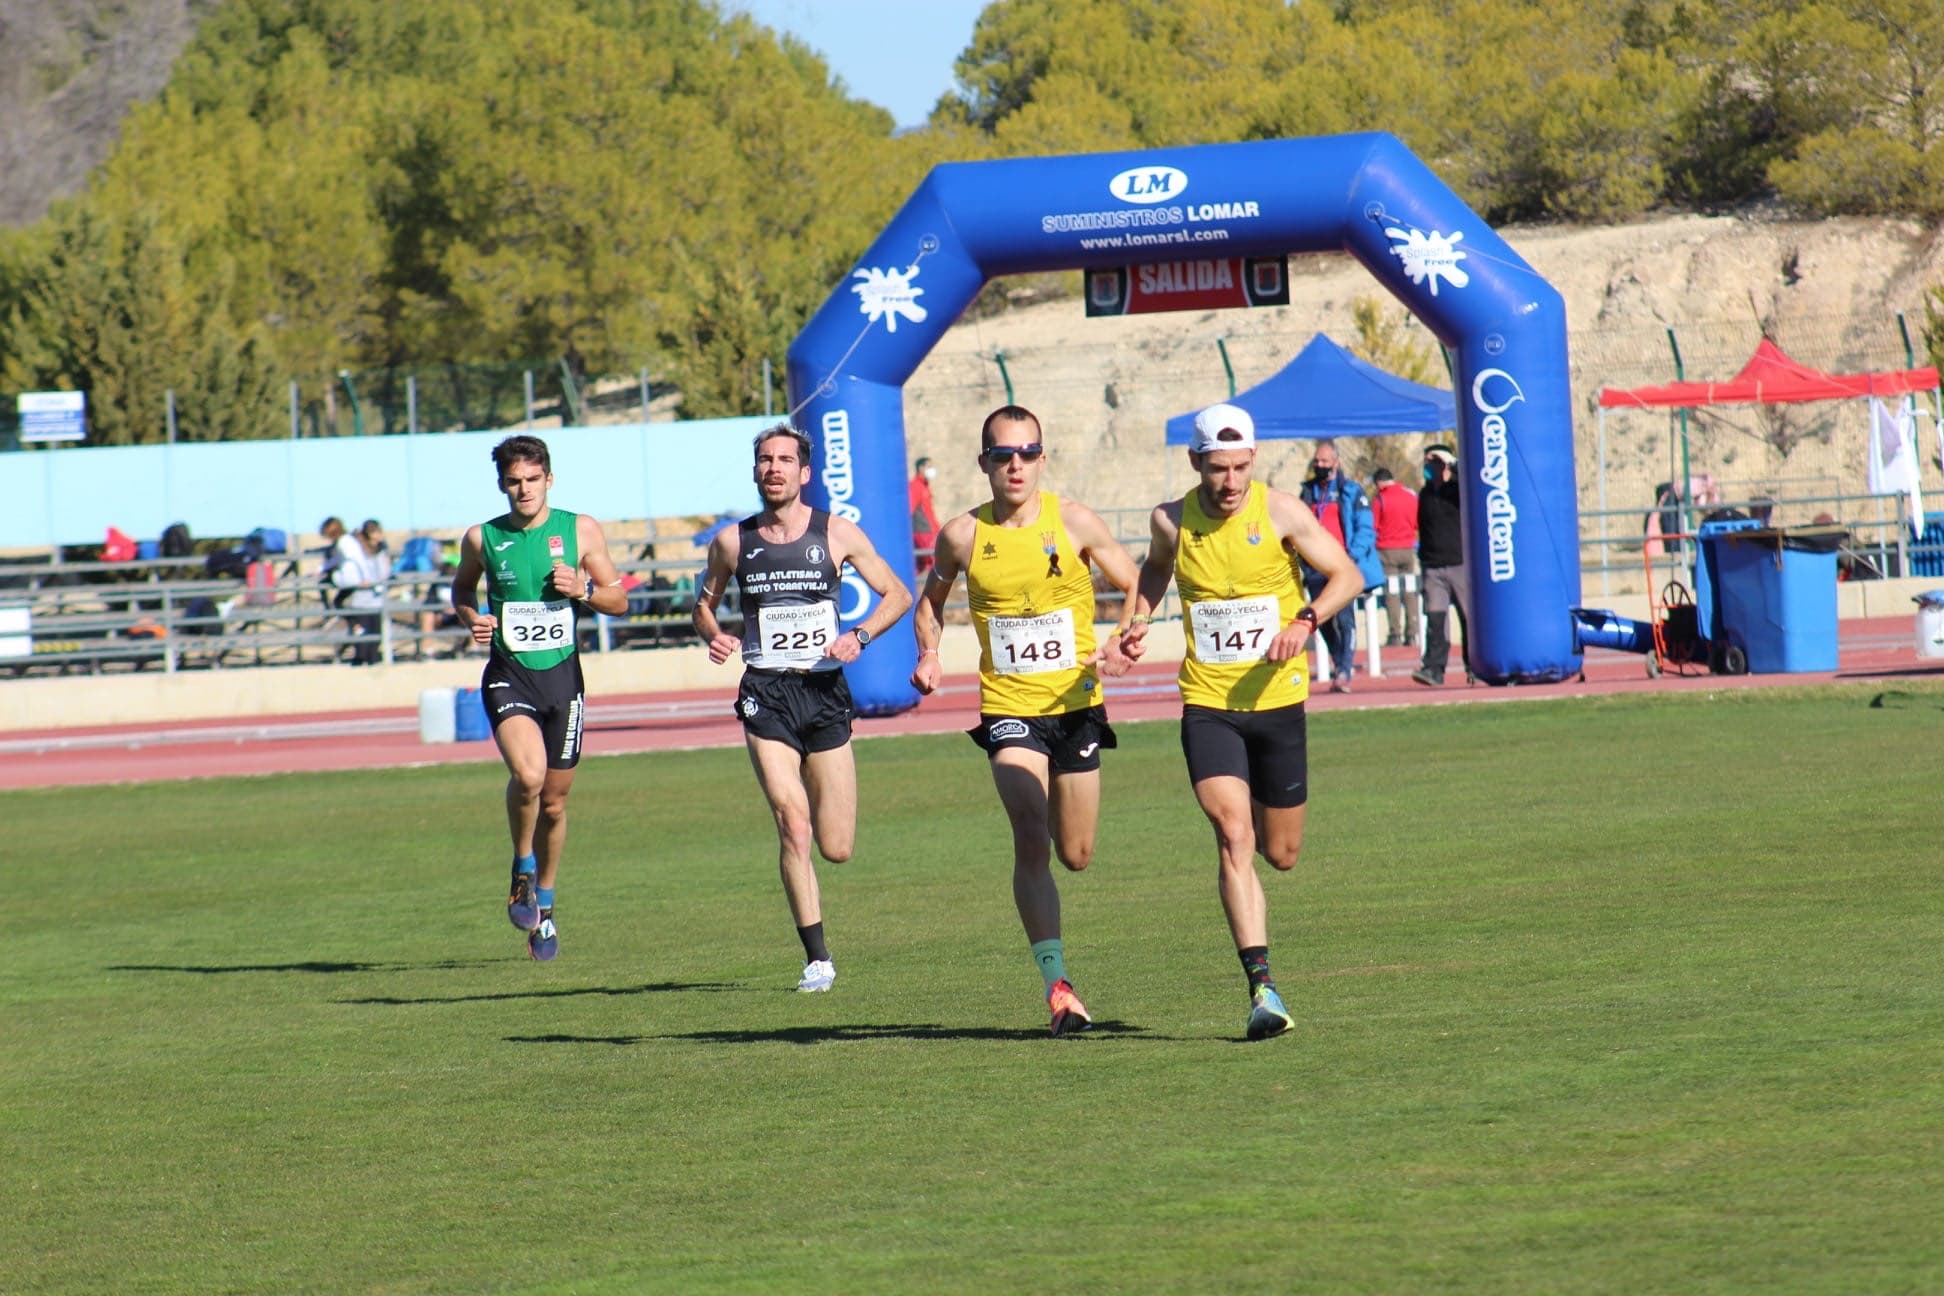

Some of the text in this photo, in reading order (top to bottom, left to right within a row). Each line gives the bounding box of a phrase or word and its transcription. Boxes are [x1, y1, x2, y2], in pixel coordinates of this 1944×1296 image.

[1125, 172, 1173, 195] LM
[1042, 201, 1260, 233] SUMINISTROS LOMAR
[1080, 228, 1229, 250] www.lomarsl.com
[1138, 258, 1234, 295] SALIDA
[1480, 414, 1517, 583] easyclean
[746, 570, 822, 583] CLUB ATLETISMO
[773, 582, 828, 591] TORREVIEJA
[765, 612, 798, 620] CIUDAD
[802, 608, 826, 618] YECLA
[1198, 607, 1232, 616] CIUDAD
[1237, 605, 1269, 614] YECLA
[512, 624, 564, 642] 326
[995, 620, 1028, 628] CIUDAD
[1033, 617, 1064, 626] YECLA
[772, 627, 827, 650] 225
[1210, 628, 1265, 652] 147
[1005, 640, 1062, 664] 148
